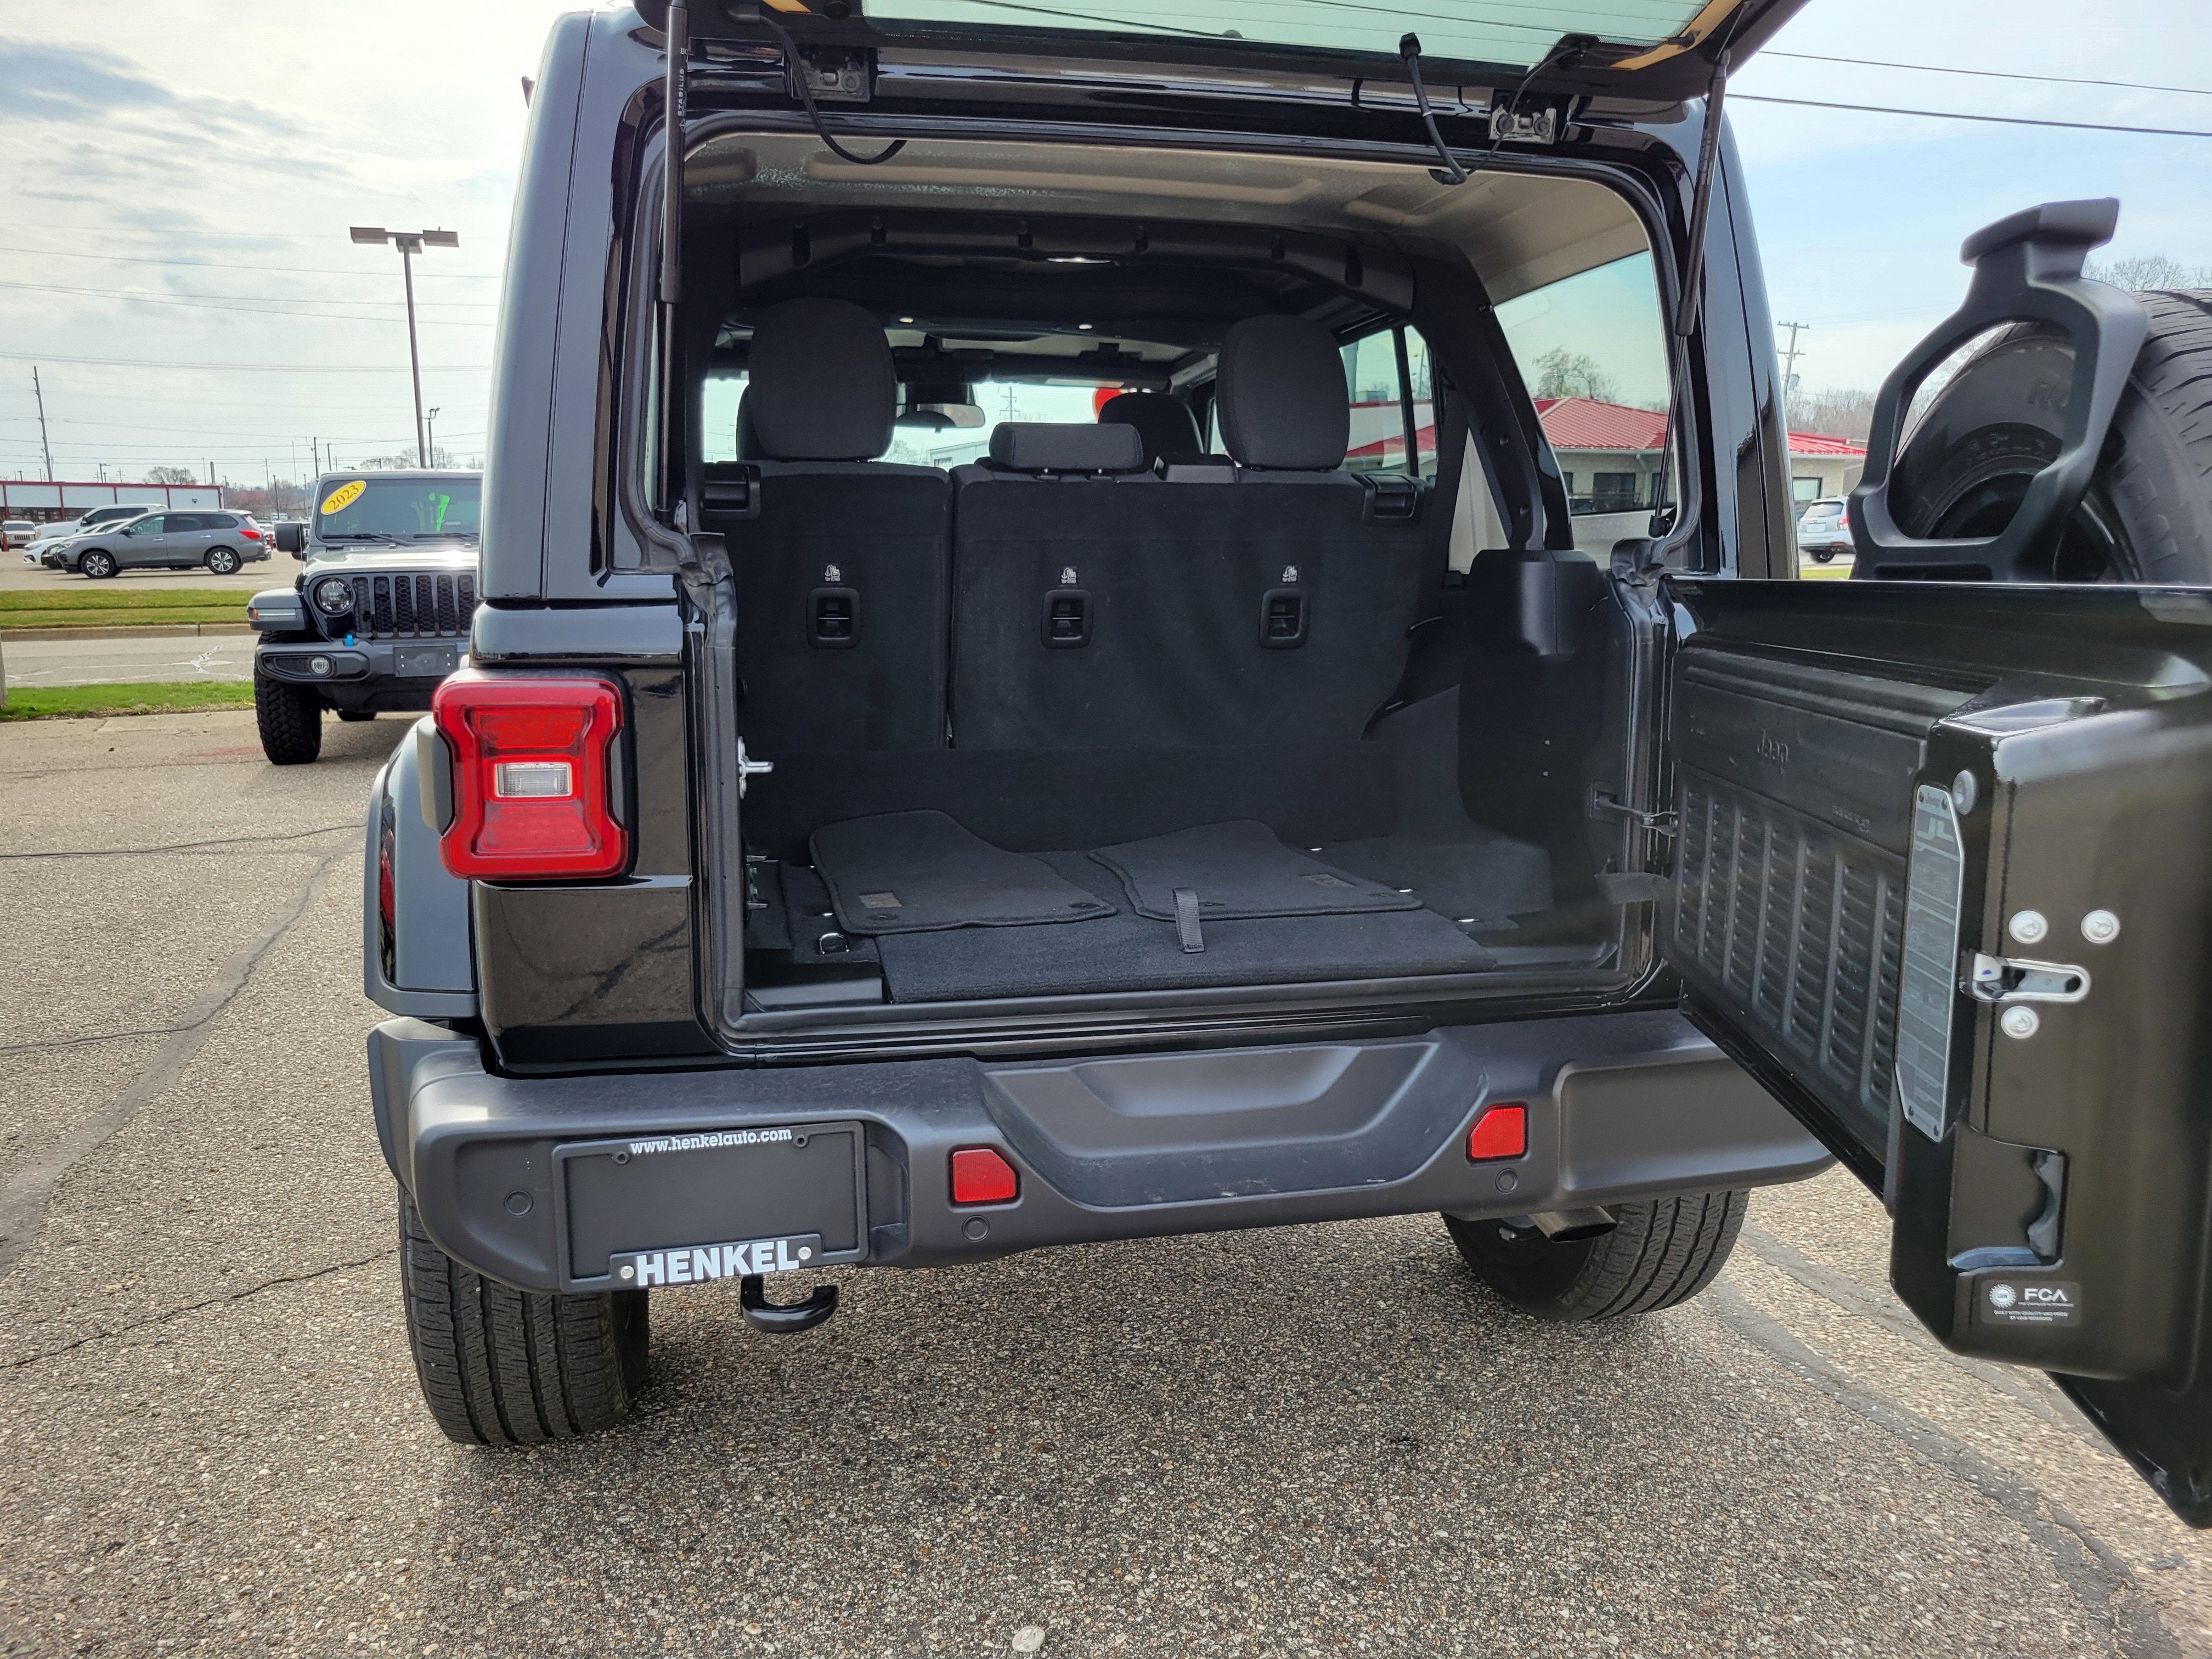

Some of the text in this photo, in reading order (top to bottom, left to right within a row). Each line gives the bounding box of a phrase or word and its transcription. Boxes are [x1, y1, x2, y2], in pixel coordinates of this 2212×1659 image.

[329, 485, 359, 510] 2023
[630, 1129, 792, 1154] www.henkelauto.com
[637, 1240, 799, 1286] HENKEL
[2024, 1288, 2068, 1301] FCA
